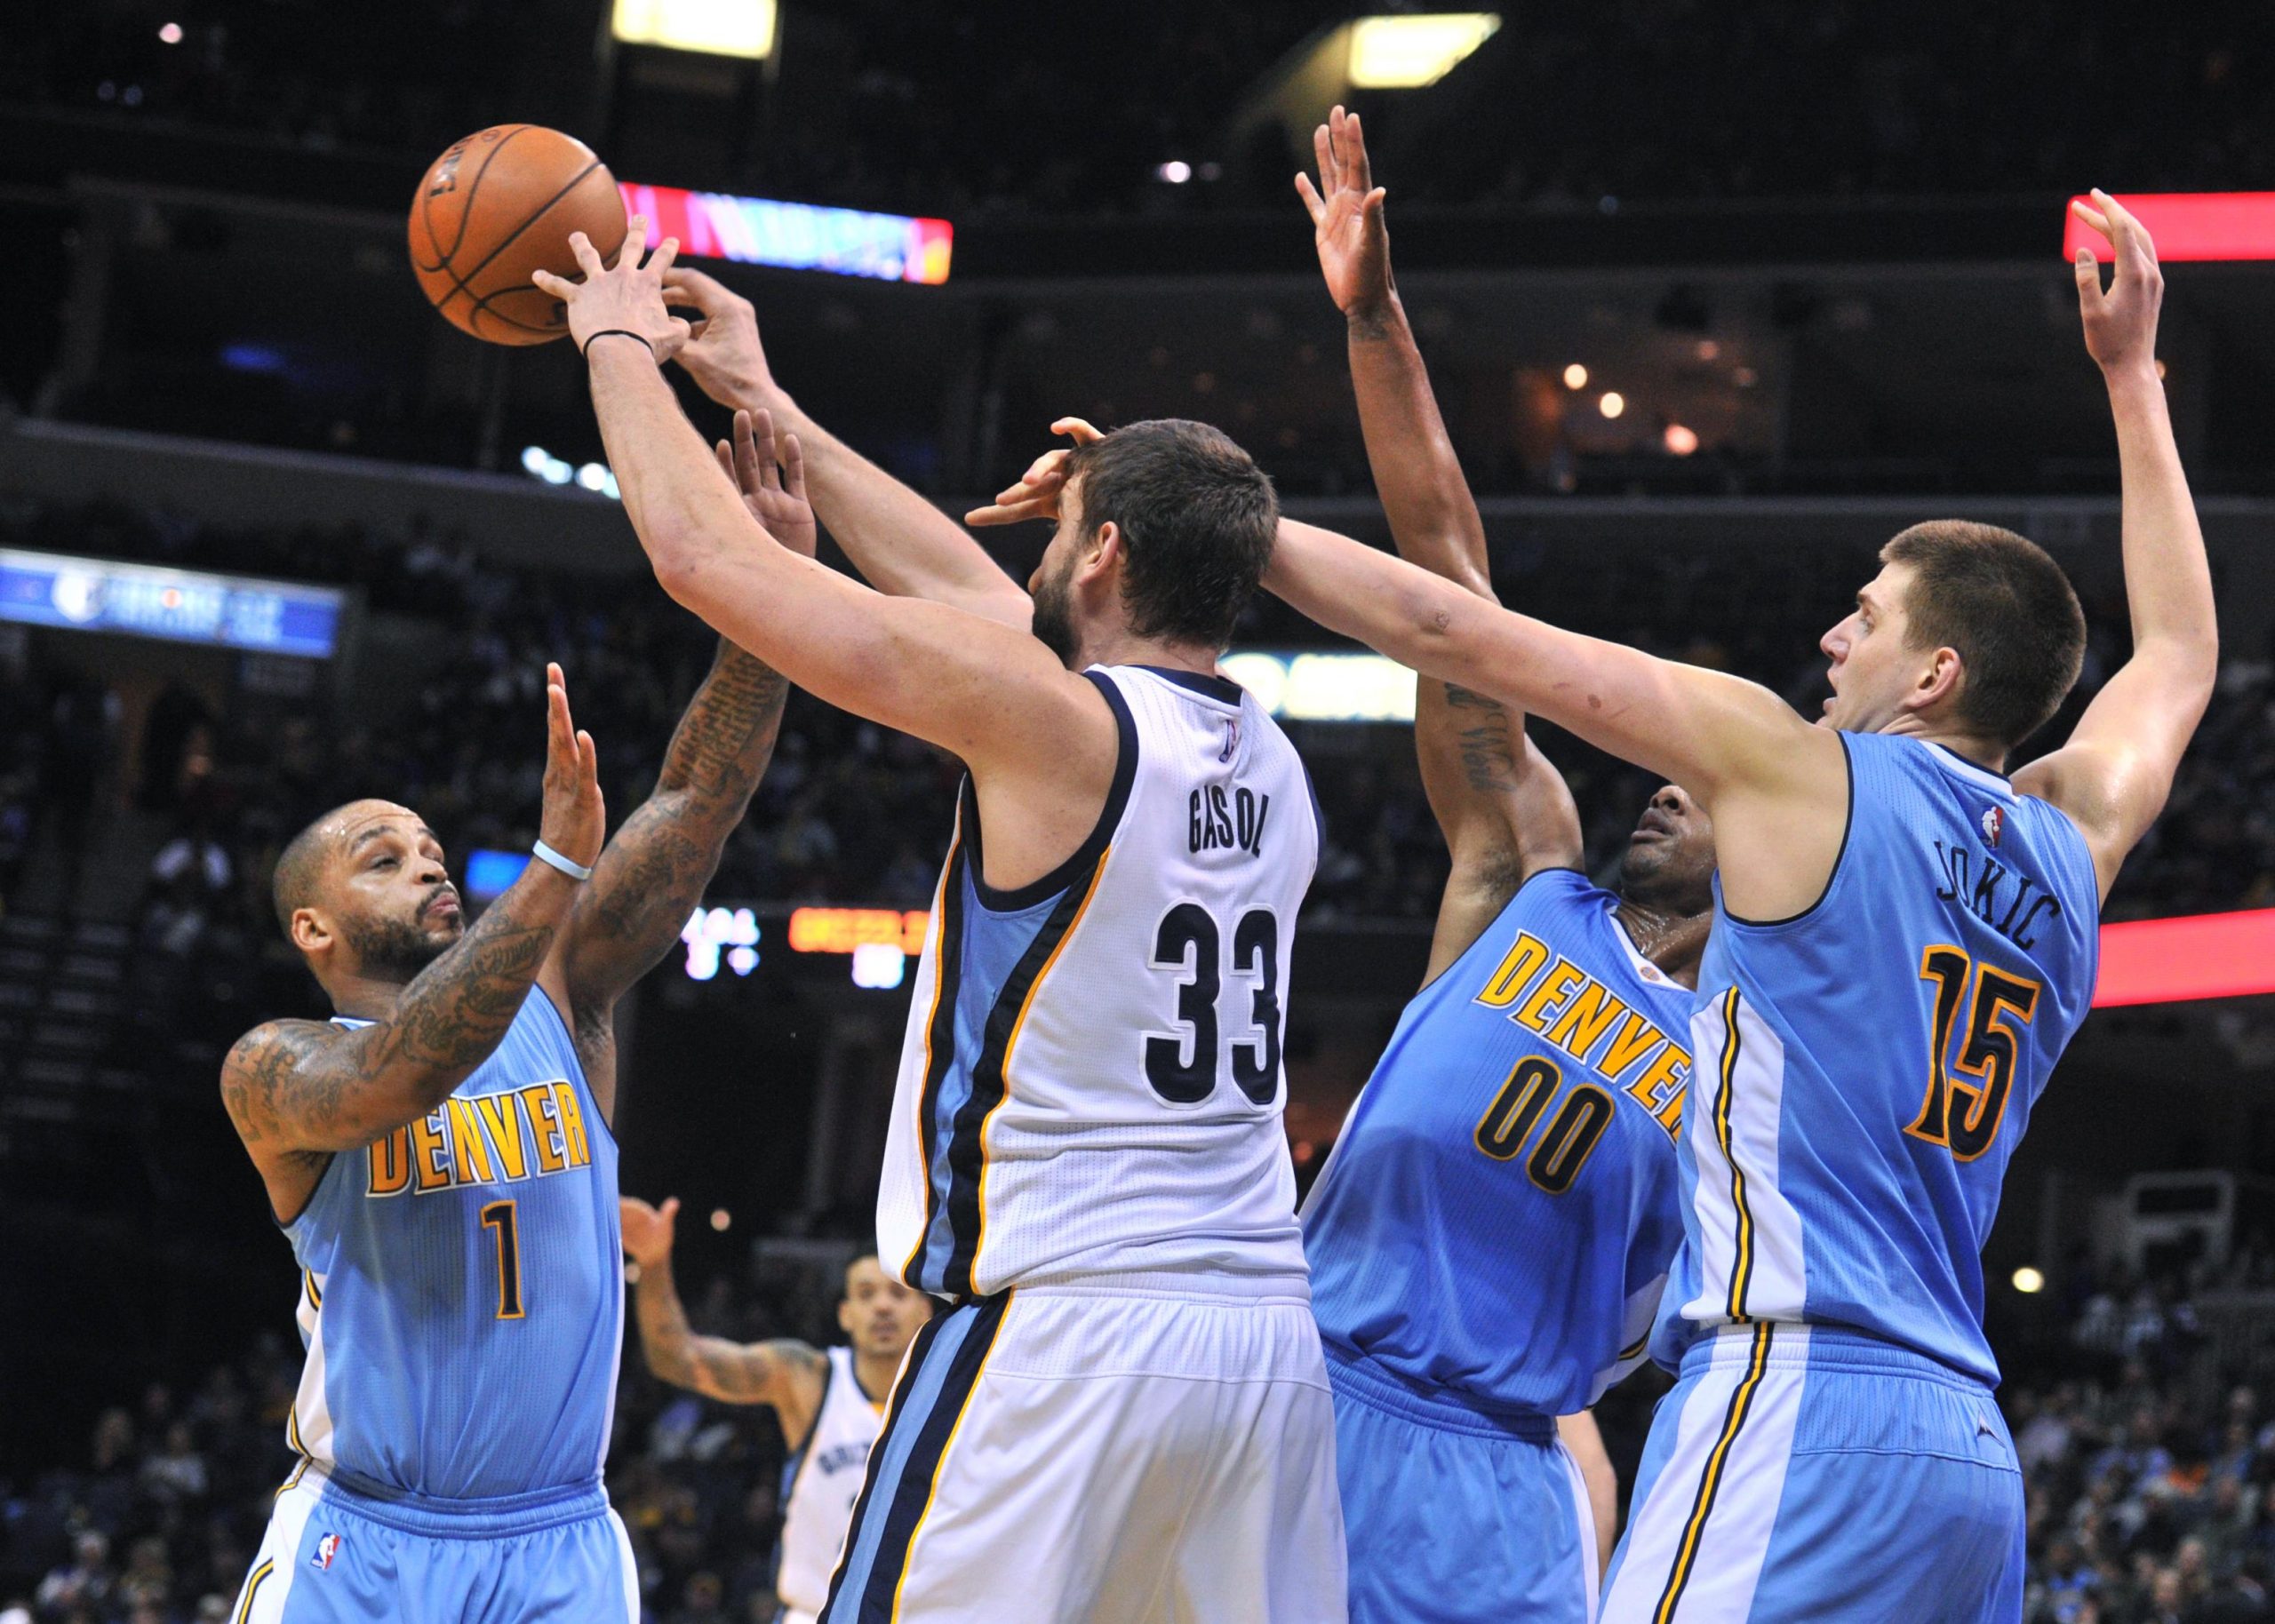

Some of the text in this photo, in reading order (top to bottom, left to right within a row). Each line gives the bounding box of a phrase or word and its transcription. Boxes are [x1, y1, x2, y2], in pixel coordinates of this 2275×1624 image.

[1188, 784, 1269, 858] GASOL
[1934, 840, 2061, 950] JOKIC
[1141, 897, 1285, 1110] 33
[1903, 944, 2041, 1162] 15
[365, 1079, 591, 1197] DENVER
[1473, 1055, 1615, 1194] 00
[481, 1200, 525, 1318] 1
